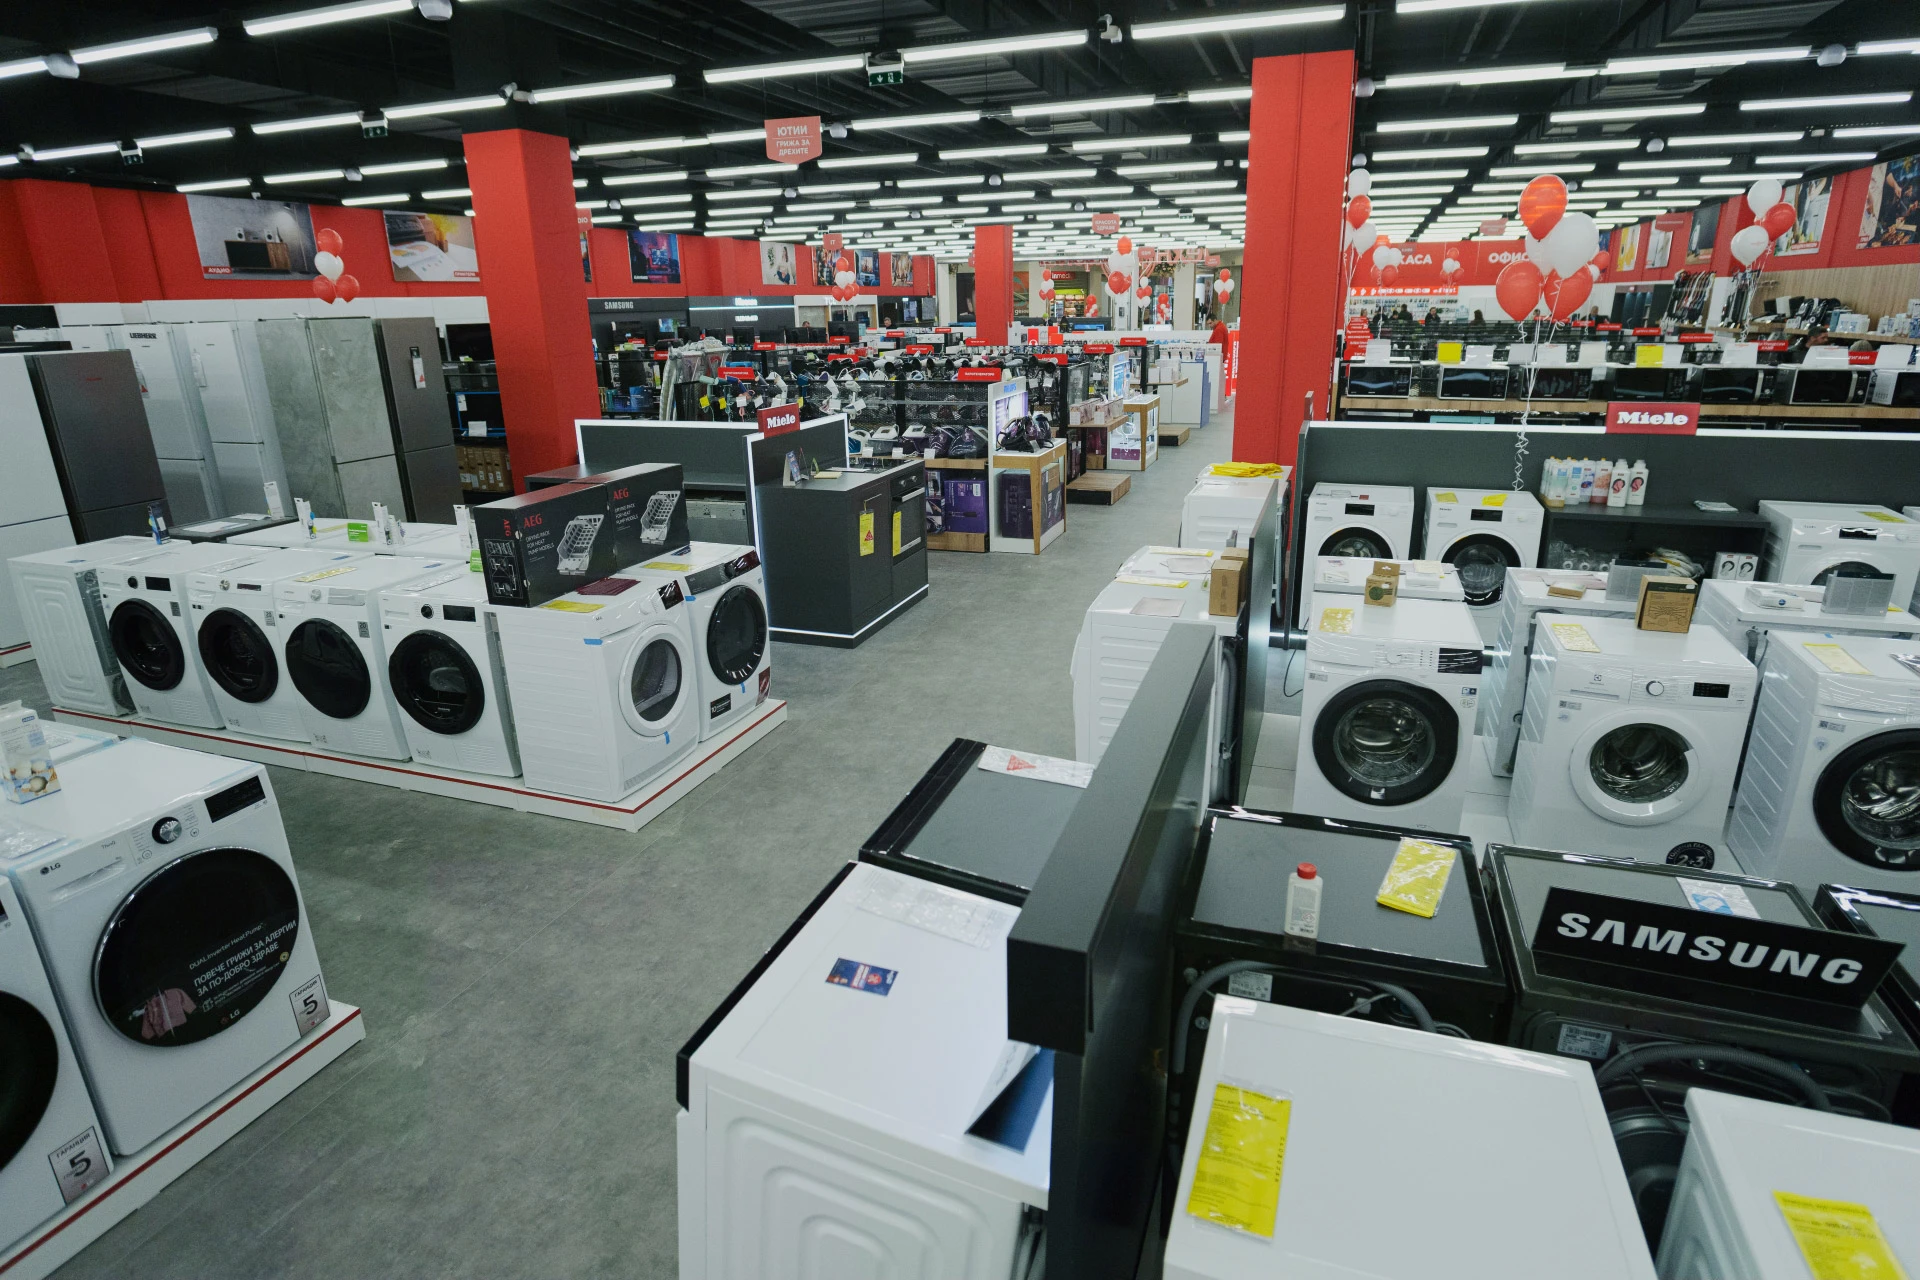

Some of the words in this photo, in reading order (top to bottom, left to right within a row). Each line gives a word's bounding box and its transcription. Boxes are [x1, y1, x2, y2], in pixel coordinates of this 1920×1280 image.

[777, 125, 808, 137] ЮТИИ
[776, 140, 800, 148] ГРИЖА
[779, 147, 809, 156] ДРЕХИТЕ
[604, 301, 634, 310] SAMSUNG
[766, 413, 796, 429] Miele
[1616, 411, 1689, 426] Miele
[613, 487, 629, 500] AEG
[503, 519, 511, 537] AEG
[523, 513, 543, 529] AEG
[534, 539, 546, 547] HEAT
[539, 542, 555, 552] MODELS
[49, 862, 61, 871] LG
[193, 963, 226, 987] ПОВЕЧЕ
[226, 946, 254, 968] ГРИЖИ
[253, 940, 265, 951] ЗА
[265, 920, 297, 945] АЛЕРГИИ
[1557, 912, 1864, 985] SAMSUNG
[197, 985, 209, 997] ЗА
[208, 959, 251, 990] ПО-ДОБРО
[250, 941, 279, 964] ЗДРАВЕ
[303, 993, 318, 1015] 5
[229, 1008, 240, 1019] LG
[69, 1149, 92, 1177] 5
